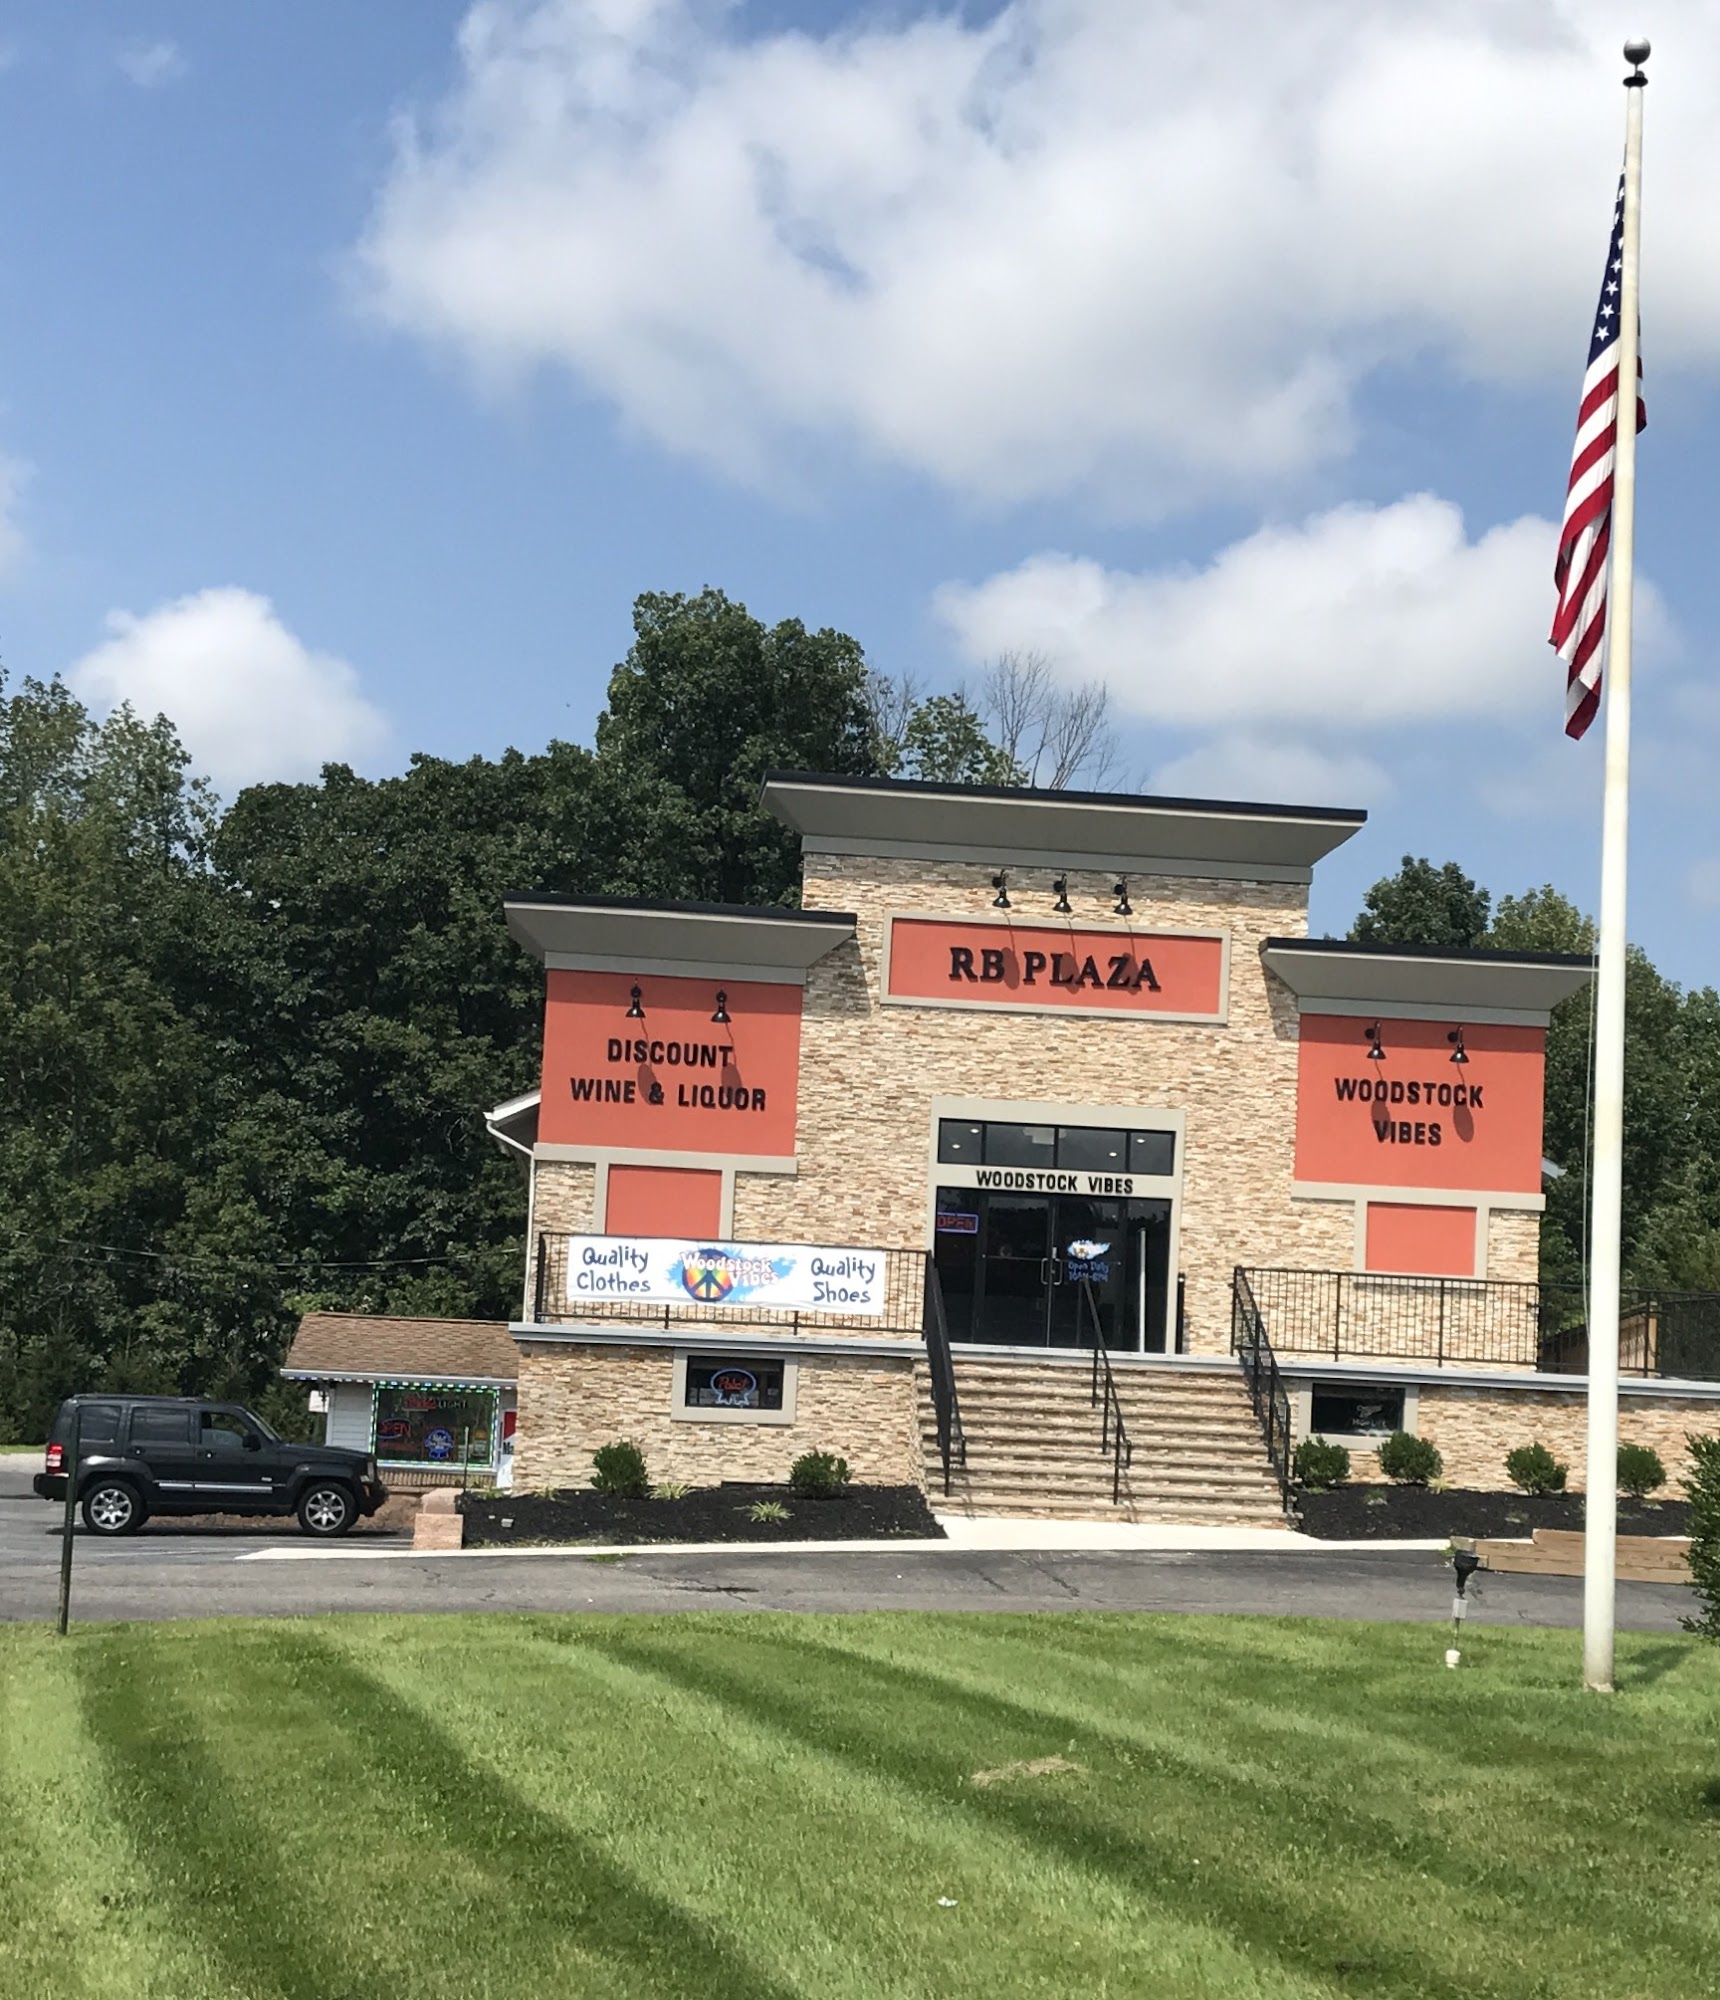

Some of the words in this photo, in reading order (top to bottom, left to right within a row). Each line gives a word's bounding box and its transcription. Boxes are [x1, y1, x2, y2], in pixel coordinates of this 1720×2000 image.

[948, 946, 1005, 983] RB
[1022, 951, 1161, 992] PLAZA
[607, 1038, 734, 1068] DISCOUNT
[570, 1077, 636, 1104] WINE
[648, 1081, 665, 1106] &
[678, 1083, 766, 1112] LIQUOR
[1335, 1077, 1484, 1109] WOODSTOCK
[1373, 1120, 1442, 1147] VIBES
[976, 1169, 1078, 1192] WOODSTOCK
[1088, 1176, 1133, 1195] VIBES
[937, 1215, 974, 1230] OPEN
[581, 1245, 649, 1274] Quality
[680, 1250, 773, 1273] Woodstock
[810, 1256, 876, 1285] Quality
[576, 1269, 652, 1294] Clothes
[729, 1270, 780, 1288] Vibes
[812, 1281, 872, 1304] Shoes
